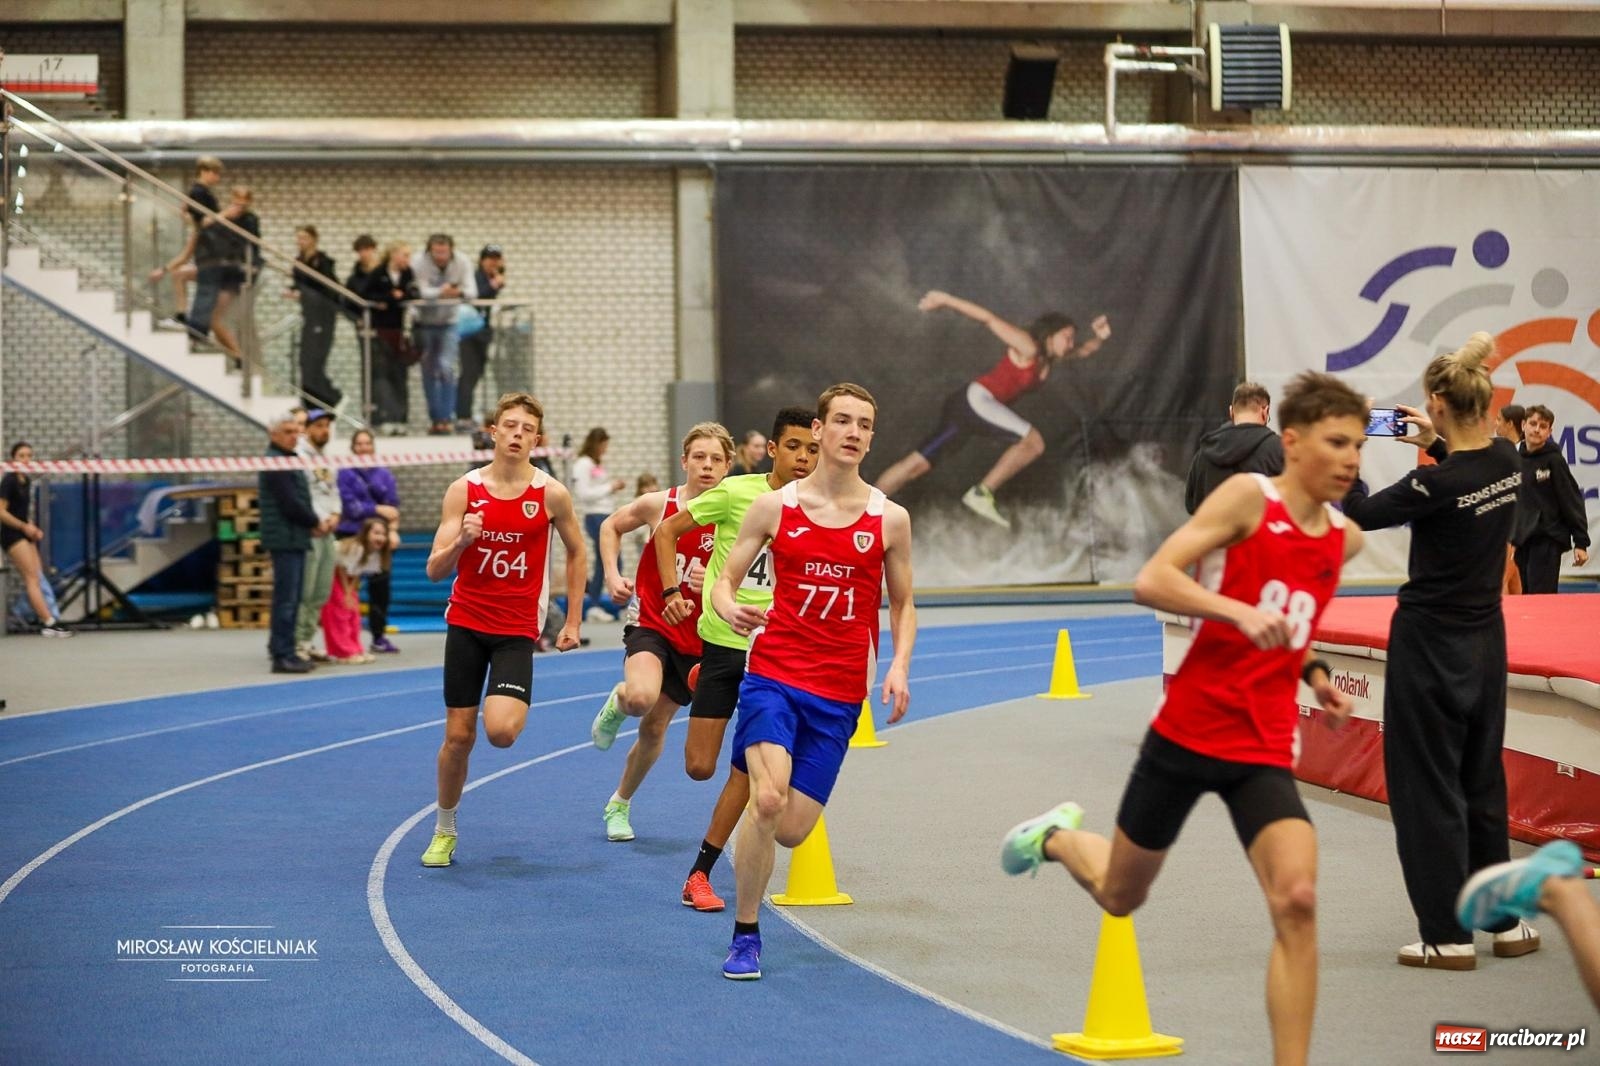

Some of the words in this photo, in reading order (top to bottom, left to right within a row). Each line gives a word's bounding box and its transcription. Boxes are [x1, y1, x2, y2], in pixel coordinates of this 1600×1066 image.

[43, 56, 63, 71] 17
[482, 530, 524, 543] PIAST
[477, 546, 528, 579] 764
[747, 552, 772, 586] 4
[805, 562, 856, 579] PIAST
[797, 583, 856, 620] 771
